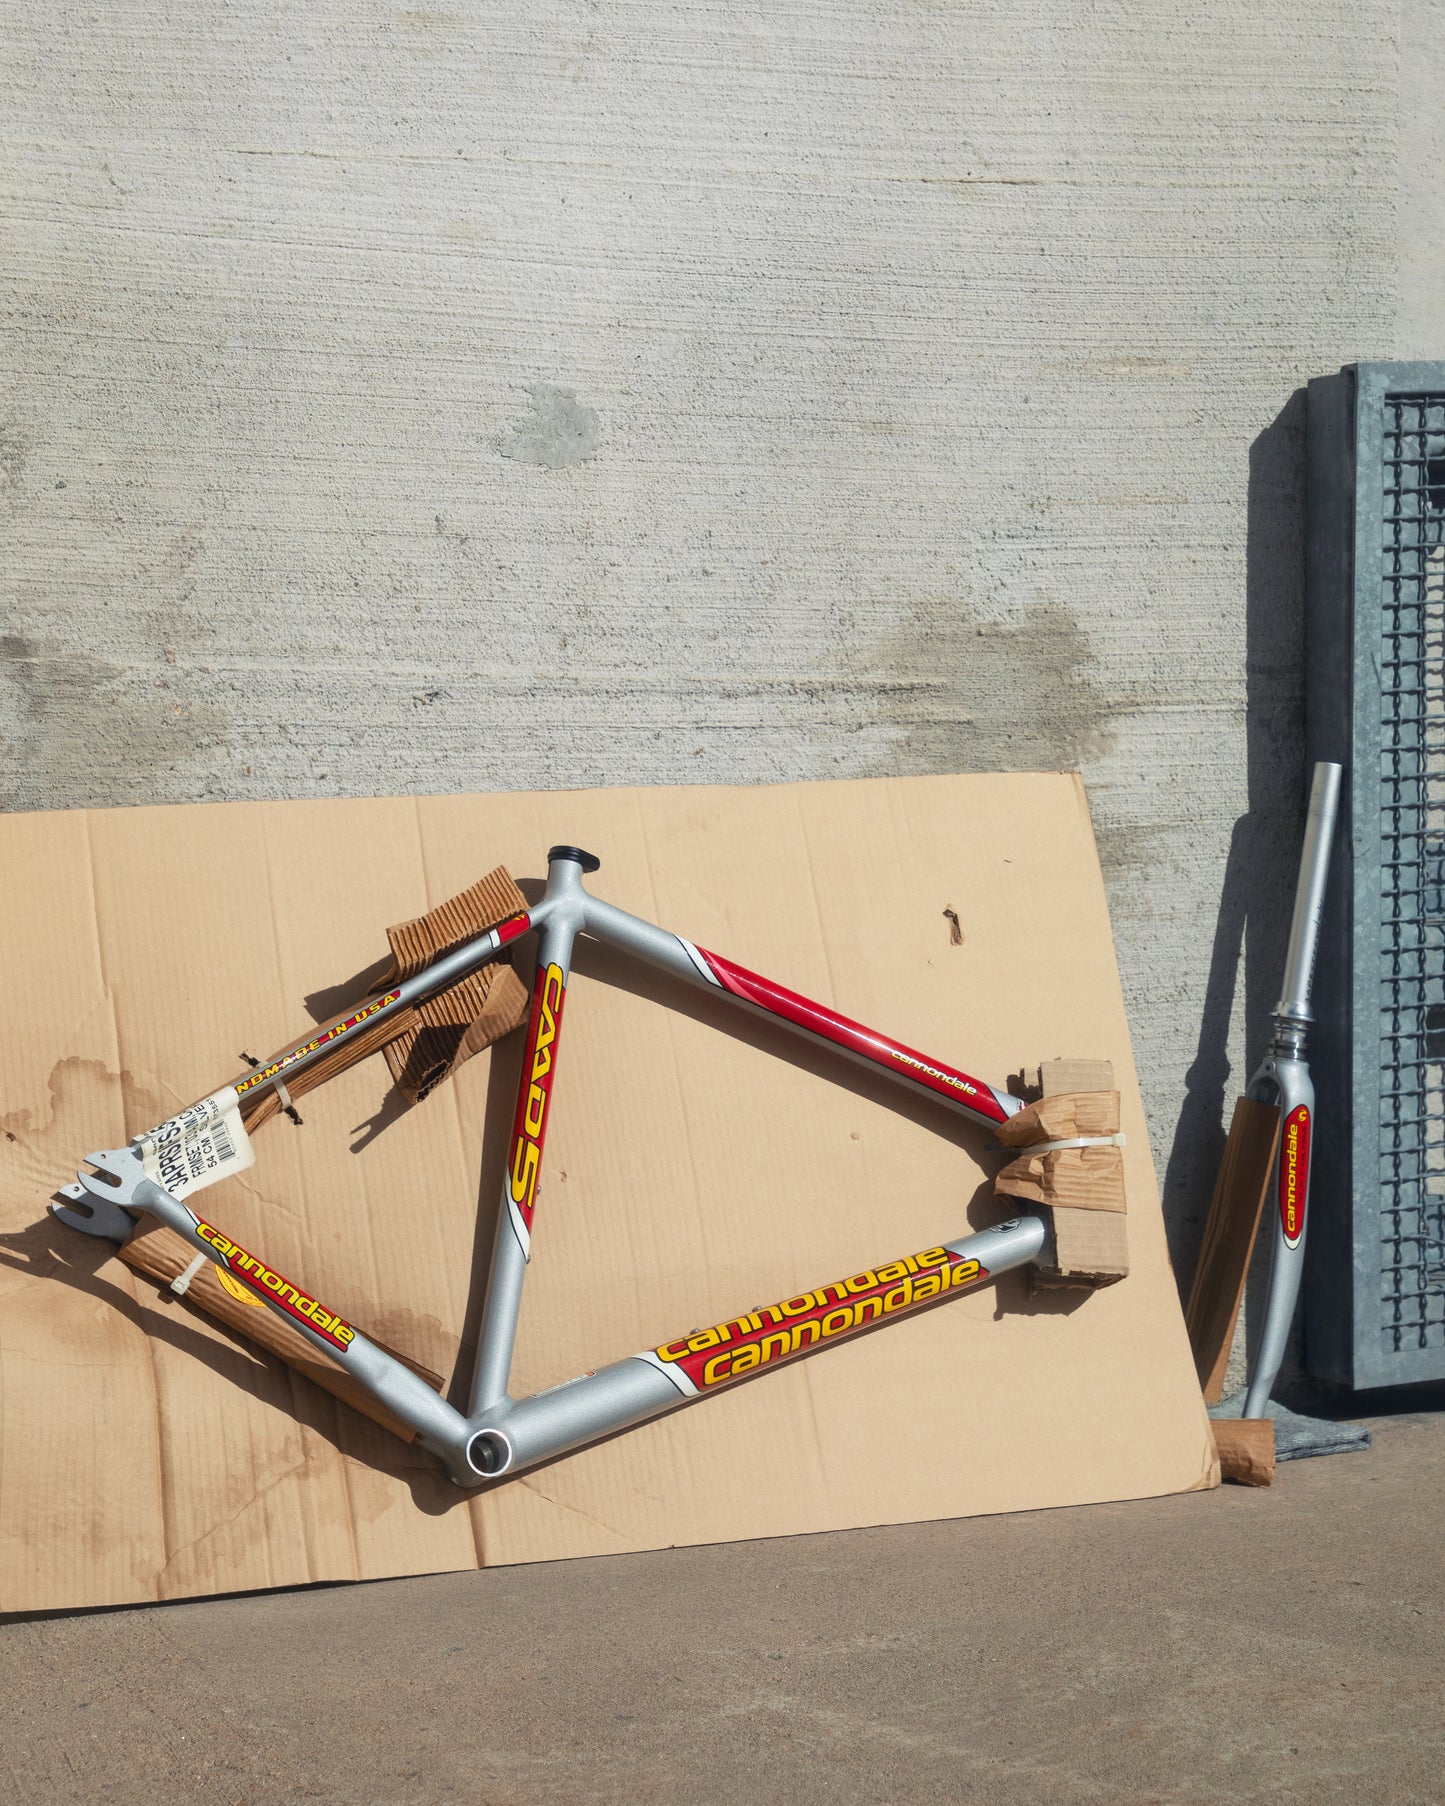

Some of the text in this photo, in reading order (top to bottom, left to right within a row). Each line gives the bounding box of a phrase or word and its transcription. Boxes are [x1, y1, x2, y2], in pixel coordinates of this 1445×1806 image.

[236, 994, 395, 1095] NDMADE IN USA
[891, 1050, 978, 1096] cannondale
[201, 1136, 213, 1154] CM
[208, 1155, 218, 1168] 54
[1287, 1123, 1299, 1233] cannondale
[195, 1223, 355, 1345] cannondale
[656, 1246, 949, 1363] cannondale
[703, 1258, 981, 1386] cannondale
